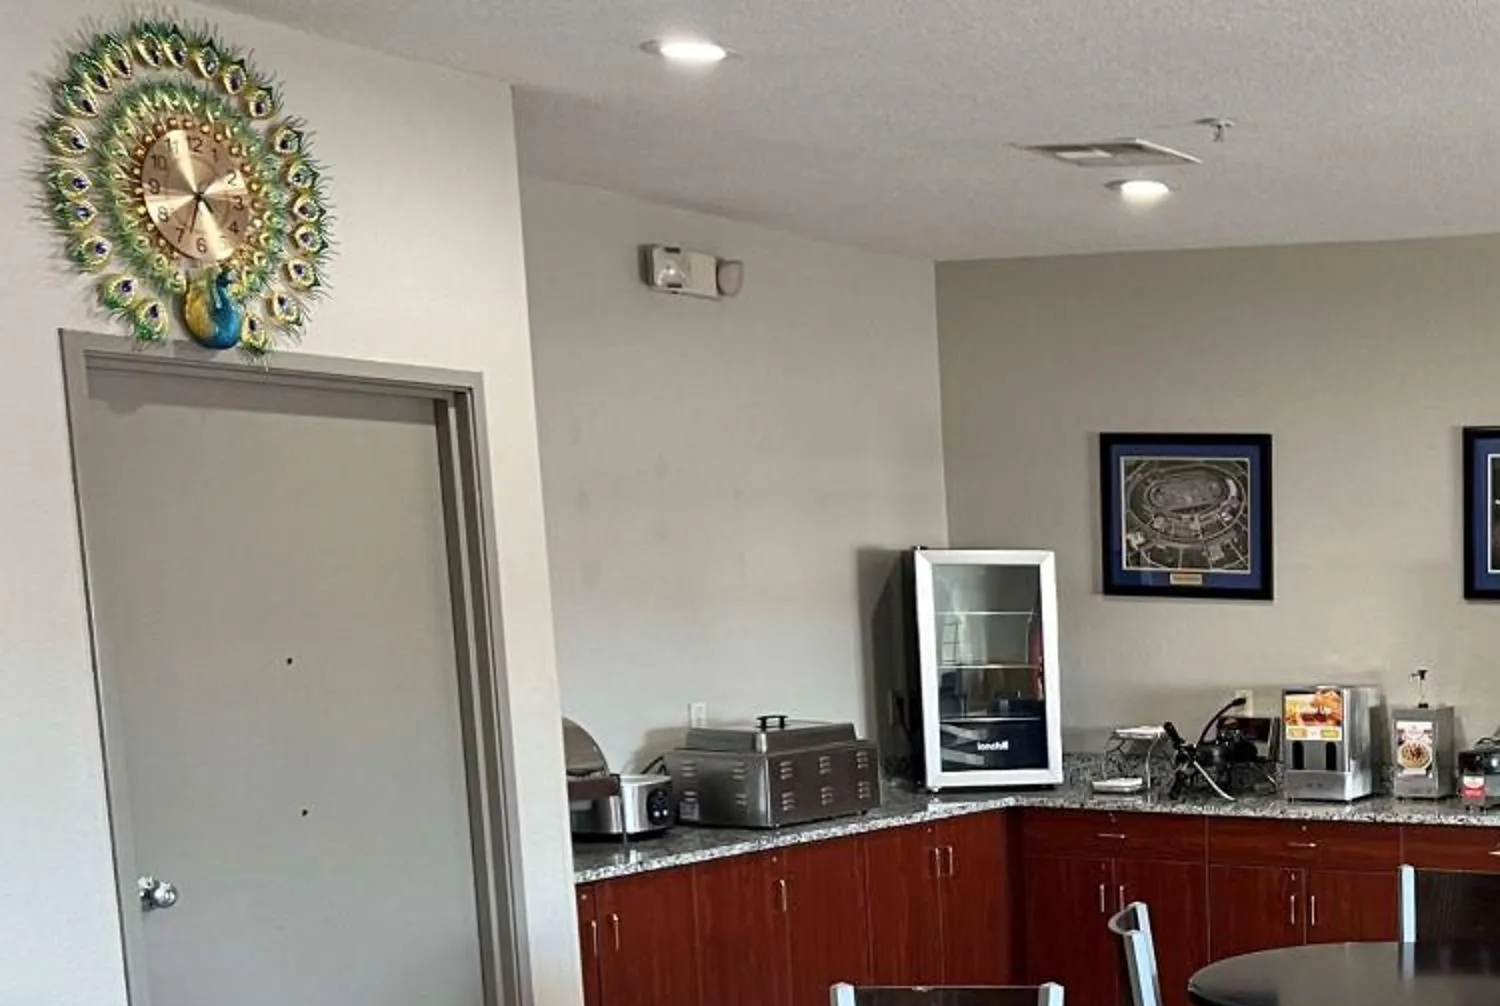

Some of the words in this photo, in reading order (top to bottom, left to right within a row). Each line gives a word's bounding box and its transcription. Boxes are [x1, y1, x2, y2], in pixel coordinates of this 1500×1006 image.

[164, 137, 179, 154] 11
[187, 136, 203, 153] 12
[149, 155, 167, 171] 10
[211, 148, 217, 162] 1
[148, 177, 160, 194] 9
[225, 169, 236, 187] 2
[233, 196, 244, 211] 3
[158, 206, 169, 222] 8
[175, 227, 184, 242] 7
[229, 220, 239, 234] 4
[196, 238, 206, 253] 6
